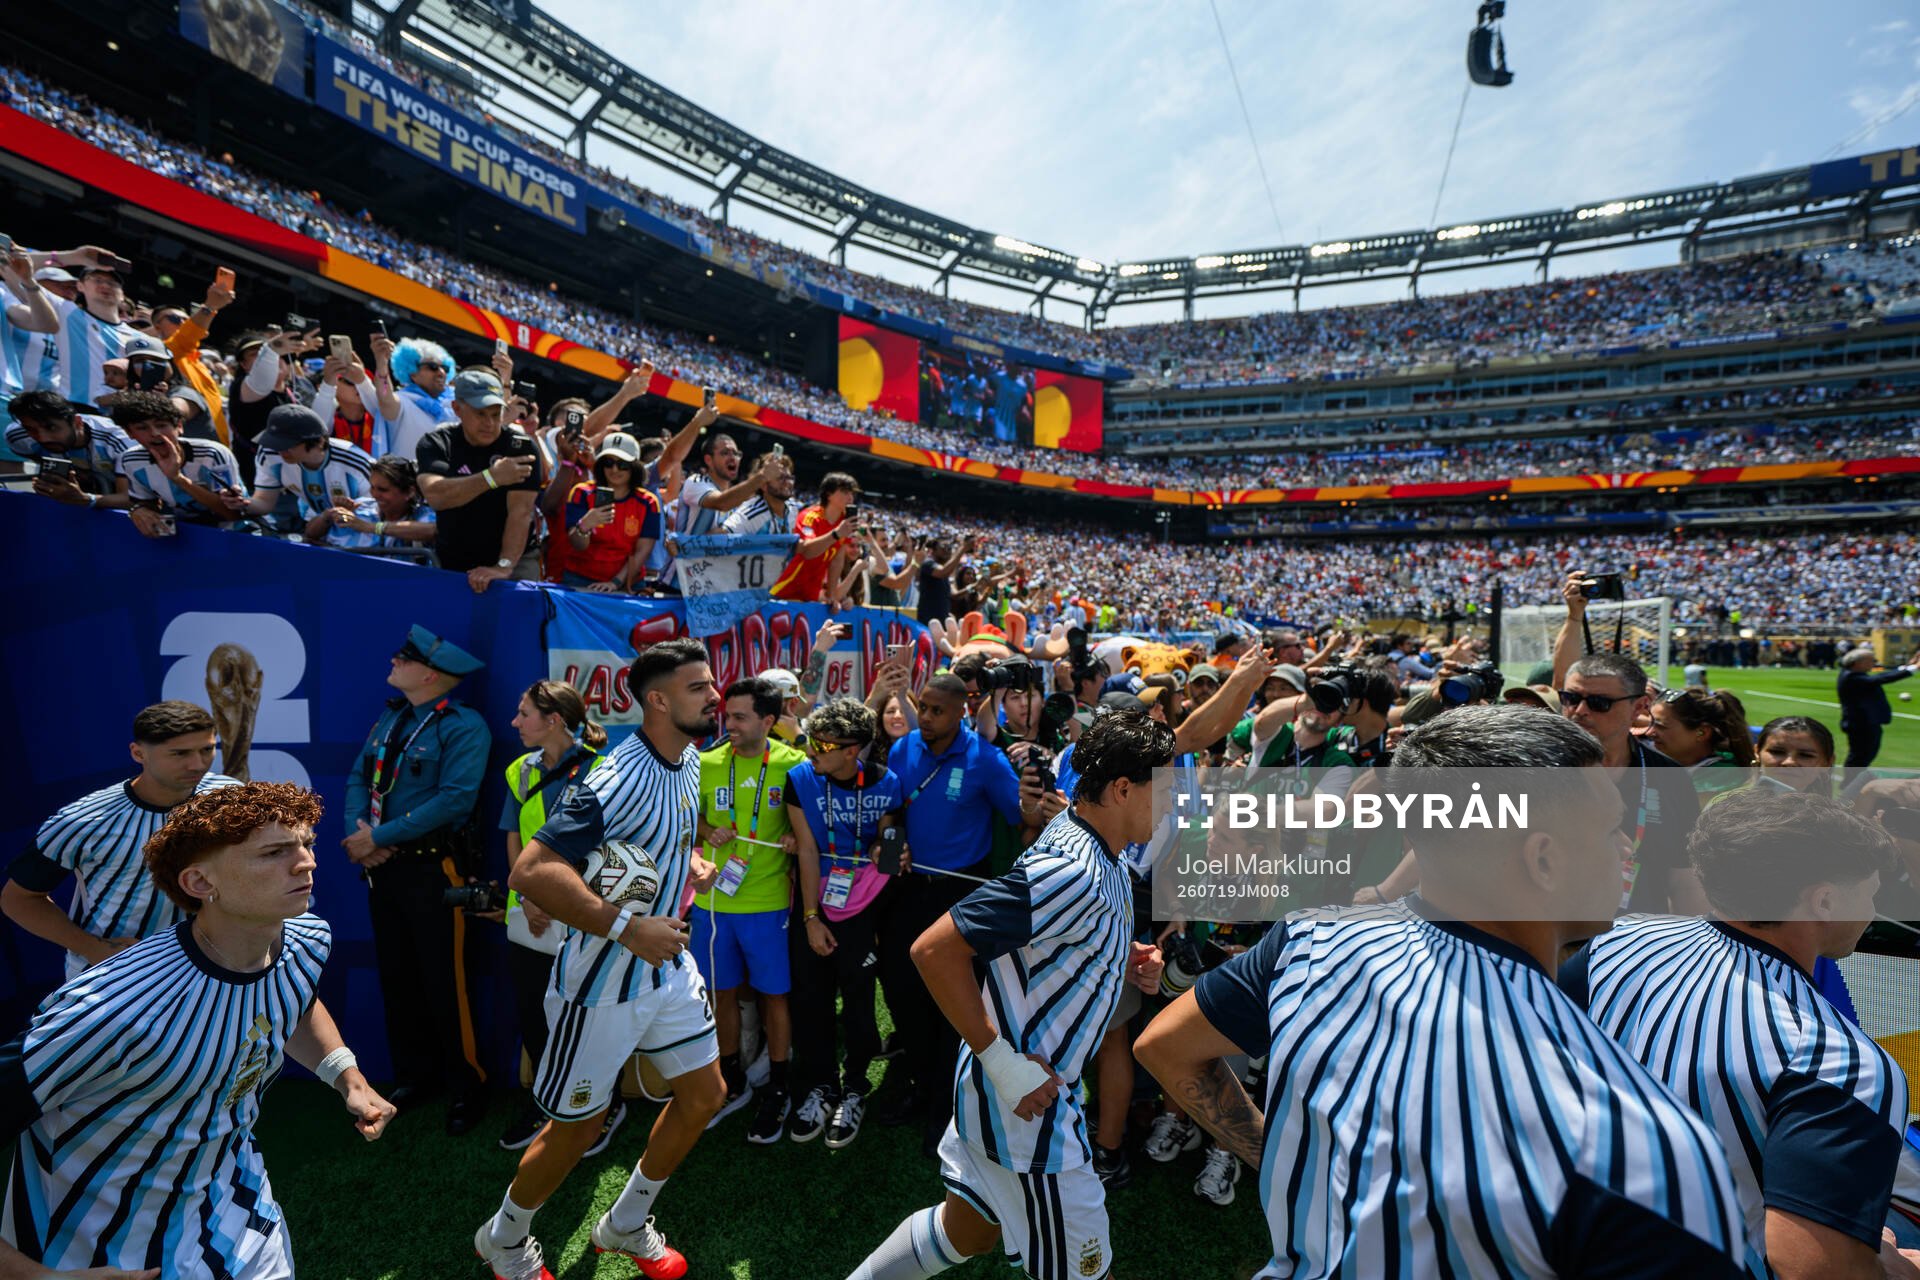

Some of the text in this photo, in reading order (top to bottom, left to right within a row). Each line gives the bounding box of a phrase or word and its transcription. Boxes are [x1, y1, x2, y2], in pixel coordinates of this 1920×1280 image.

[334, 56, 577, 200] FIFA WORLD CUP 2026
[334, 76, 576, 227] THE FINAL
[737, 555, 764, 588] 10
[826, 660, 853, 696] DE
